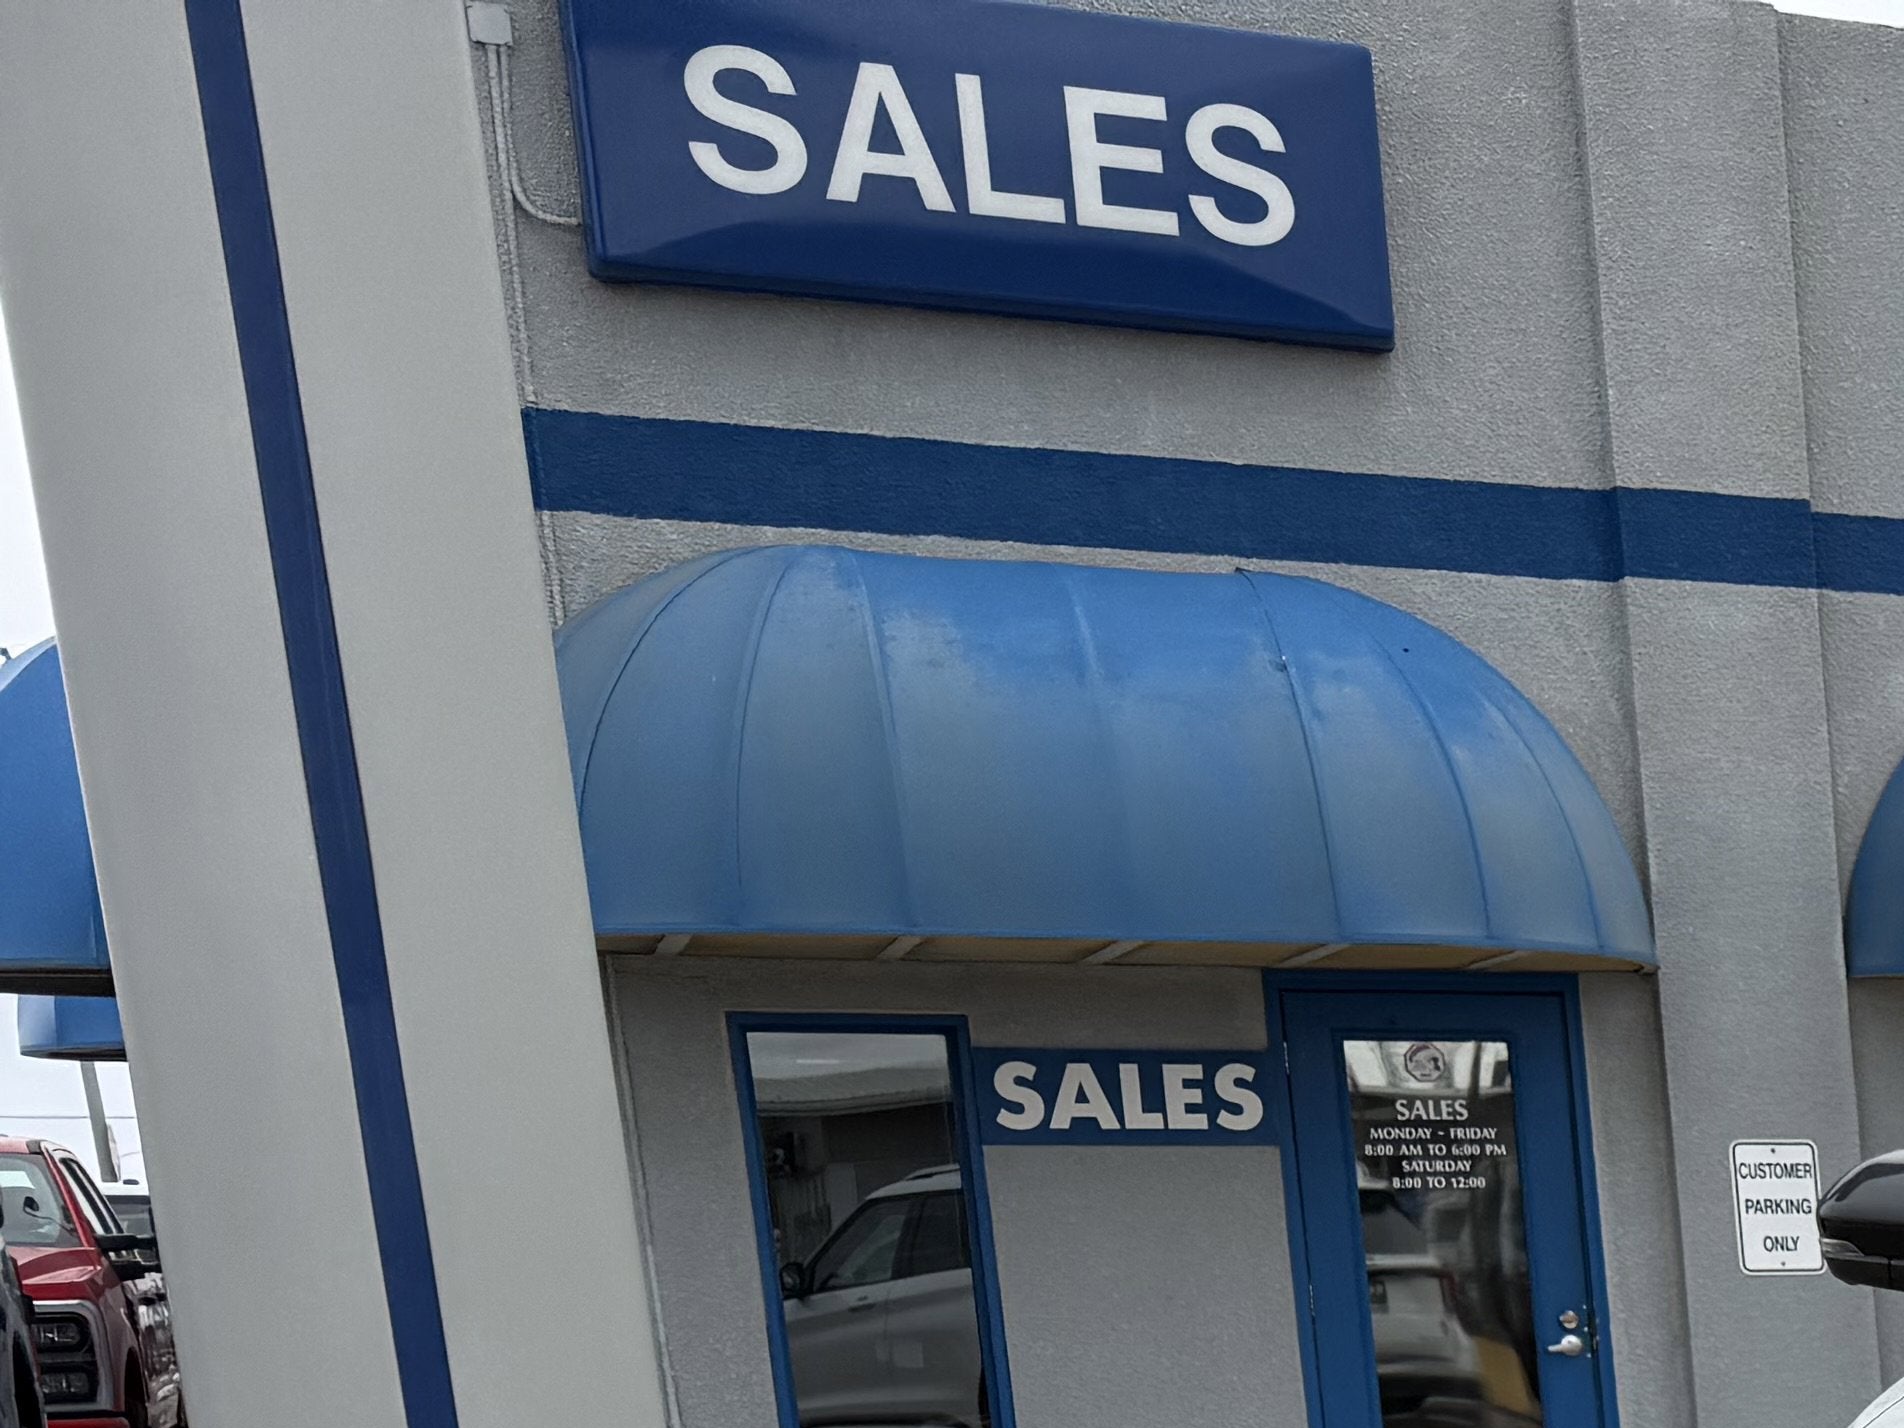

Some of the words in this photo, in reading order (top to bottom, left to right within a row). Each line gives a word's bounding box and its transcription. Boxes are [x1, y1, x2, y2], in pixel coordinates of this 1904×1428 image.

[683, 44, 1295, 246] SALES
[993, 1061, 1264, 1131] SALES
[1395, 1099, 1469, 1121] SALES
[1369, 1127, 1432, 1140] MONDAY
[1449, 1127, 1497, 1140] FRIDAY
[1364, 1144, 1394, 1156] 8:00
[1400, 1144, 1423, 1156] AM
[1427, 1144, 1446, 1156] TO
[1451, 1144, 1480, 1156] 6:00
[1485, 1144, 1507, 1156] PM
[1401, 1160, 1472, 1172] SATURDAY
[1738, 1163, 1812, 1179] CUSTOMER
[1392, 1177, 1421, 1189] 8:00
[1426, 1177, 1446, 1189] TO
[1451, 1177, 1486, 1189] 12:00
[1745, 1198, 1812, 1215] PARKING
[1763, 1235, 1800, 1252] ONLY
